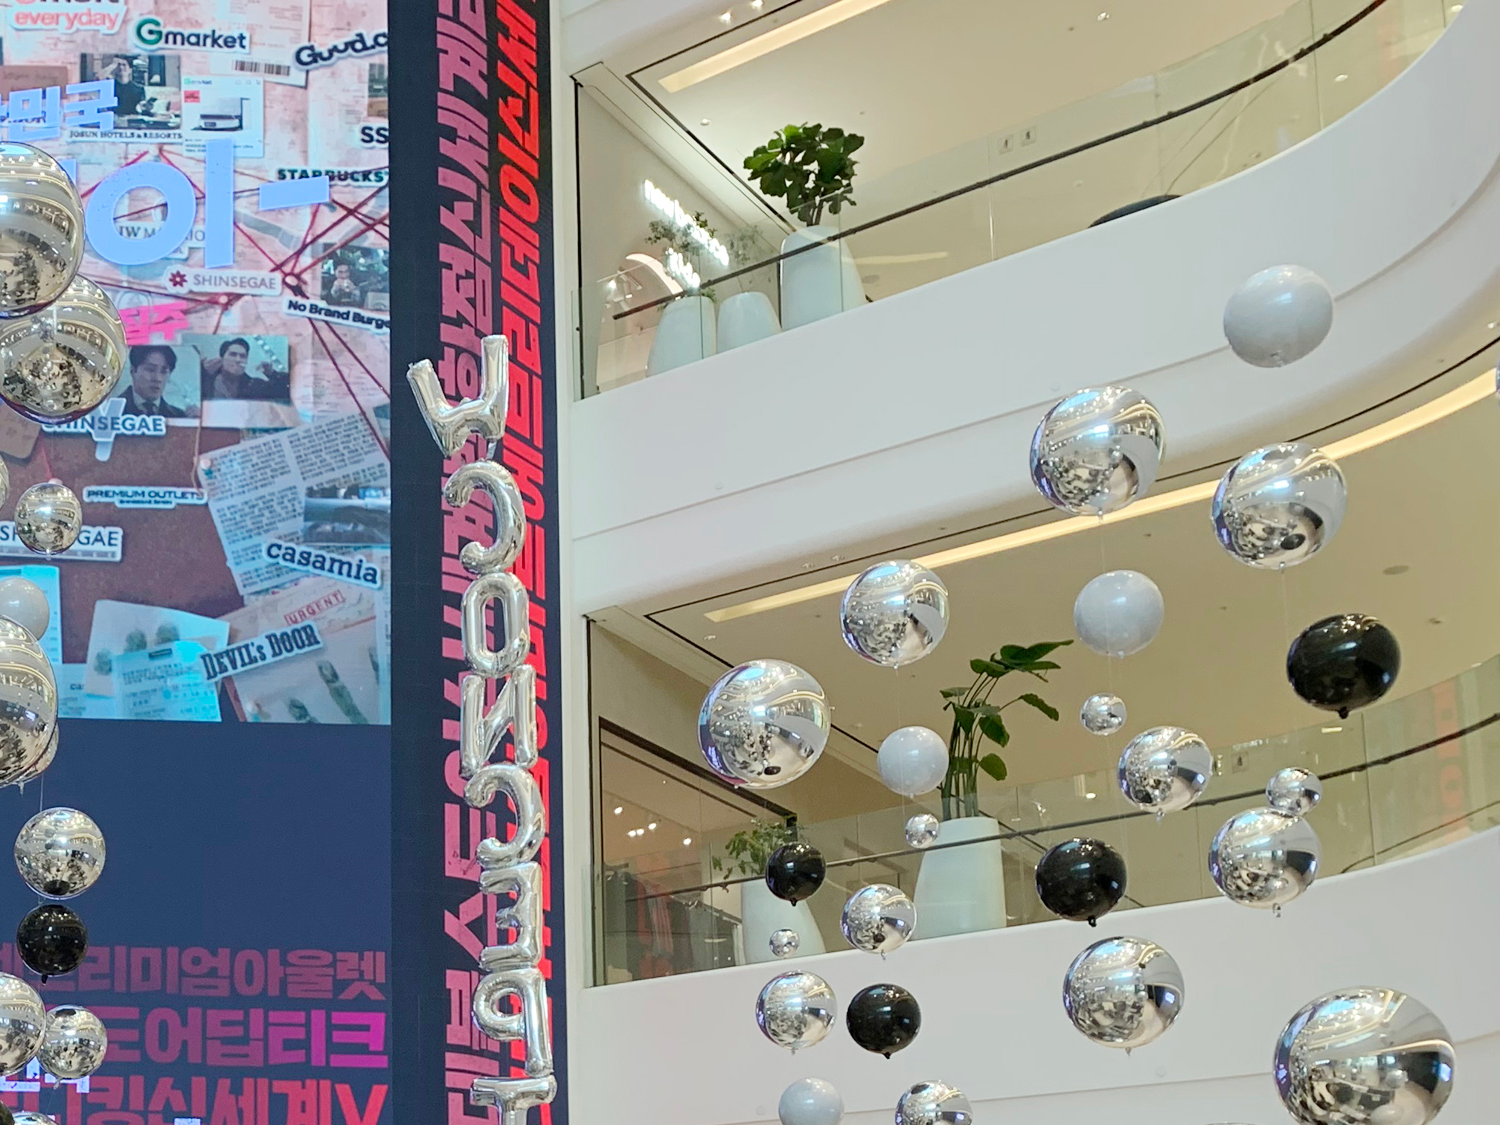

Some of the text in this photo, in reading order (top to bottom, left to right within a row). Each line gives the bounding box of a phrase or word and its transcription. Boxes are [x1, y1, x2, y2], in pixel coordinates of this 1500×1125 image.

[14, 7, 119, 31] everyday
[136, 18, 247, 49] Gmarket
[69, 130, 97, 138] JOSUN
[100, 130, 136, 139] HOTELS
[143, 131, 183, 140] RESORTS
[192, 273, 277, 289] SHINSEGAE
[288, 300, 307, 313] No
[308, 303, 350, 322] Brand
[87, 490, 145, 499] PREMIUM
[266, 541, 379, 585] casamia
[285, 591, 344, 625] URGENT
[266, 623, 321, 657] DOOR
